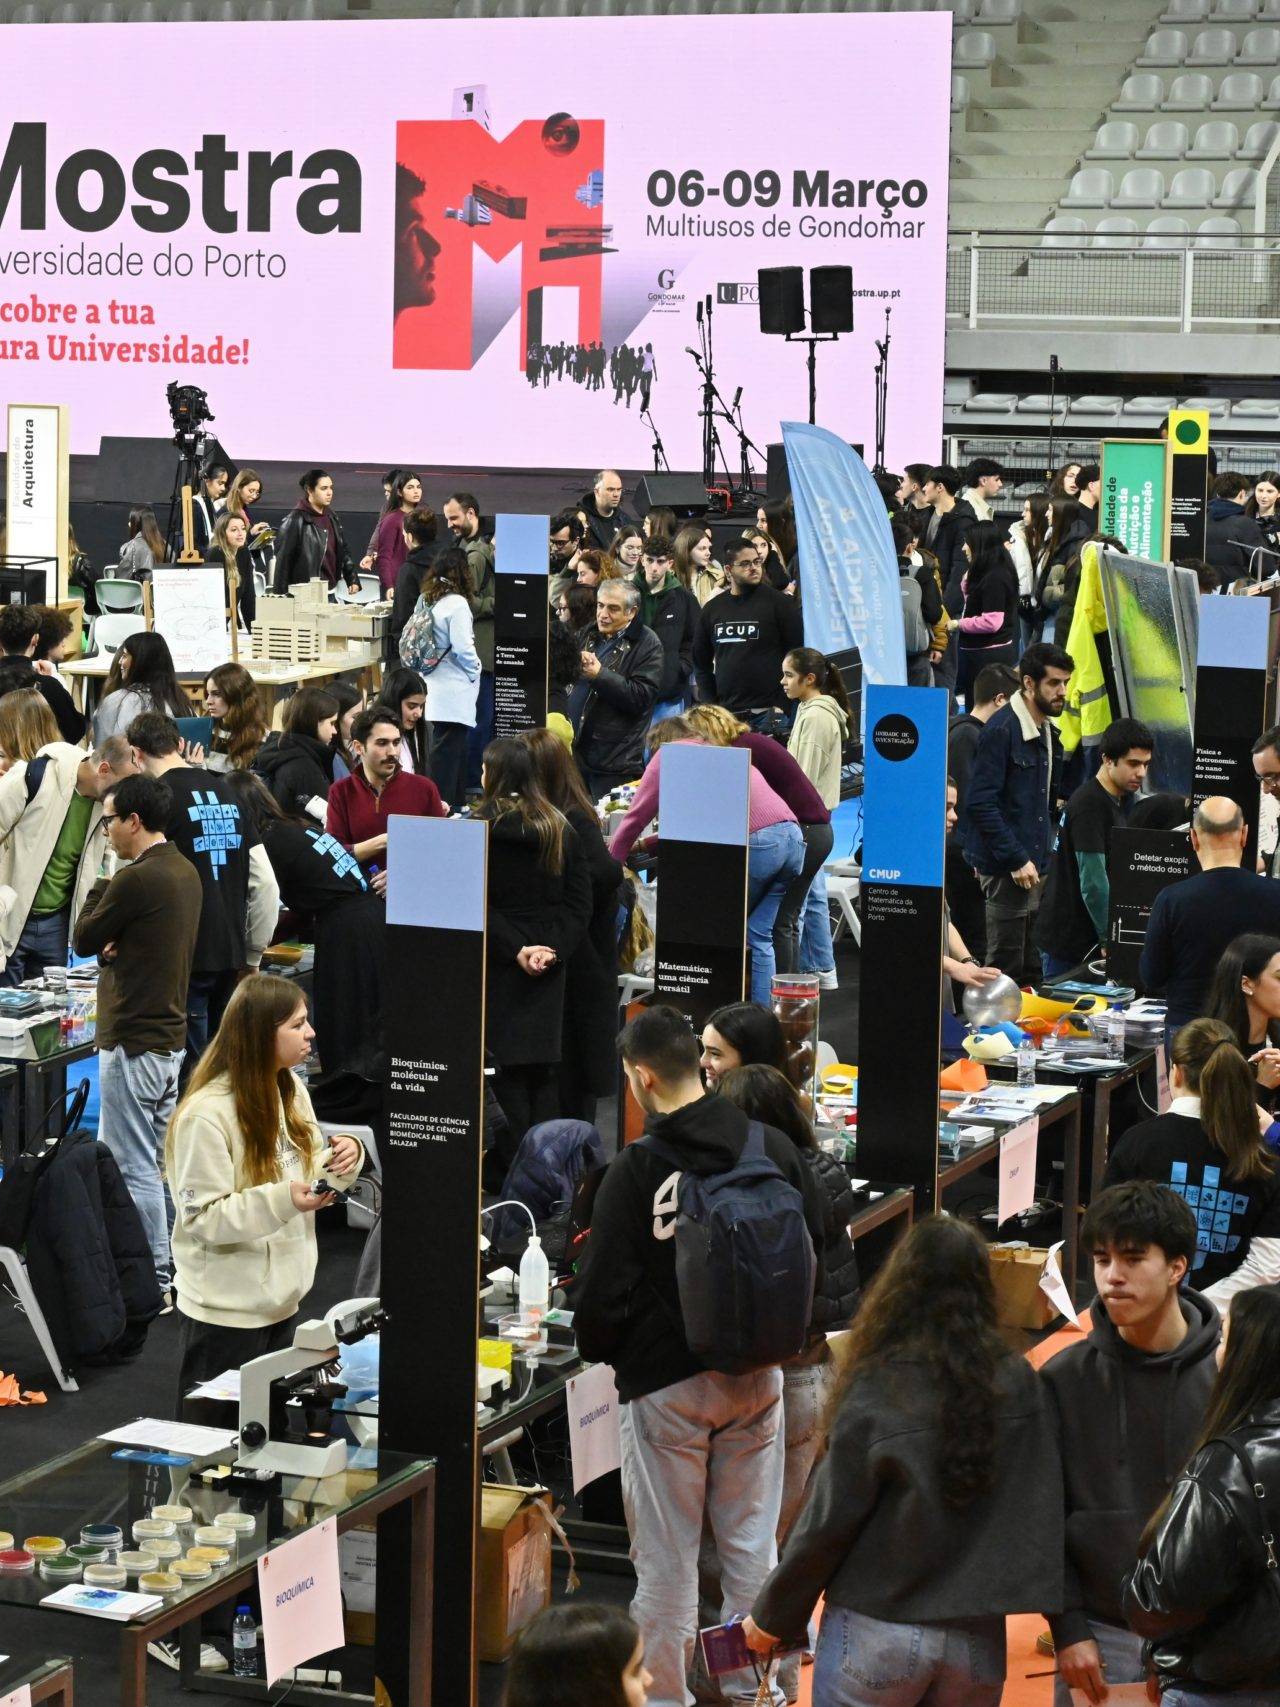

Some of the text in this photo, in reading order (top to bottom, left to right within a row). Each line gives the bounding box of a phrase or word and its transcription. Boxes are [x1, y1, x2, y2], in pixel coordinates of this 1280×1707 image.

[647, 169, 928, 219] 06-09 Março
[646, 213, 925, 238] Multiusos de Gondomar
[153, 245, 193, 277] do
[204, 245, 287, 279] Porto
[658, 269, 675, 290] G
[852, 288, 901, 300] ostra.up.pt
[85, 301, 101, 323] a
[108, 299, 155, 325] tua
[47, 333, 249, 364] Universidade!
[23, 419, 35, 508] Arquitetura
[1106, 477, 1116, 492] de
[1117, 488, 1128, 503] da
[1131, 495, 1140, 503] e
[1140, 481, 1155, 560] Alimentação
[717, 625, 756, 637] FCUP
[496, 645, 529, 653] Construindo
[1196, 748, 1217, 756] Física
[1134, 852, 1162, 863] Detetar
[869, 868, 901, 880] CMUP
[1136, 863, 1166, 873] método
[1167, 866, 1182, 874] dos
[868, 887, 899, 896] Centro de
[868, 896, 904, 905] Matemática
[868, 905, 917, 915] Universidade do
[868, 913, 885, 921] Porto
[659, 962, 712, 973] Matemática:
[679, 974, 709, 984] ciência
[658, 985, 691, 993] versátil
[391, 1057, 448, 1071] Bioquímica:
[391, 1071, 439, 1082] moléculas
[390, 1081, 425, 1092] da vida
[390, 1112, 428, 1122] FACULDADE
[439, 1117, 470, 1126] CIÊNCIAS
[389, 1121, 425, 1131] INSTITUTO
[436, 1125, 466, 1135] CIÊNCIAS
[389, 1130, 447, 1142] BIOMÉDICAS ABEL
[389, 1139, 418, 1147] SALAZAR
[275, 1576, 315, 1607] BIOQUÍMICA
